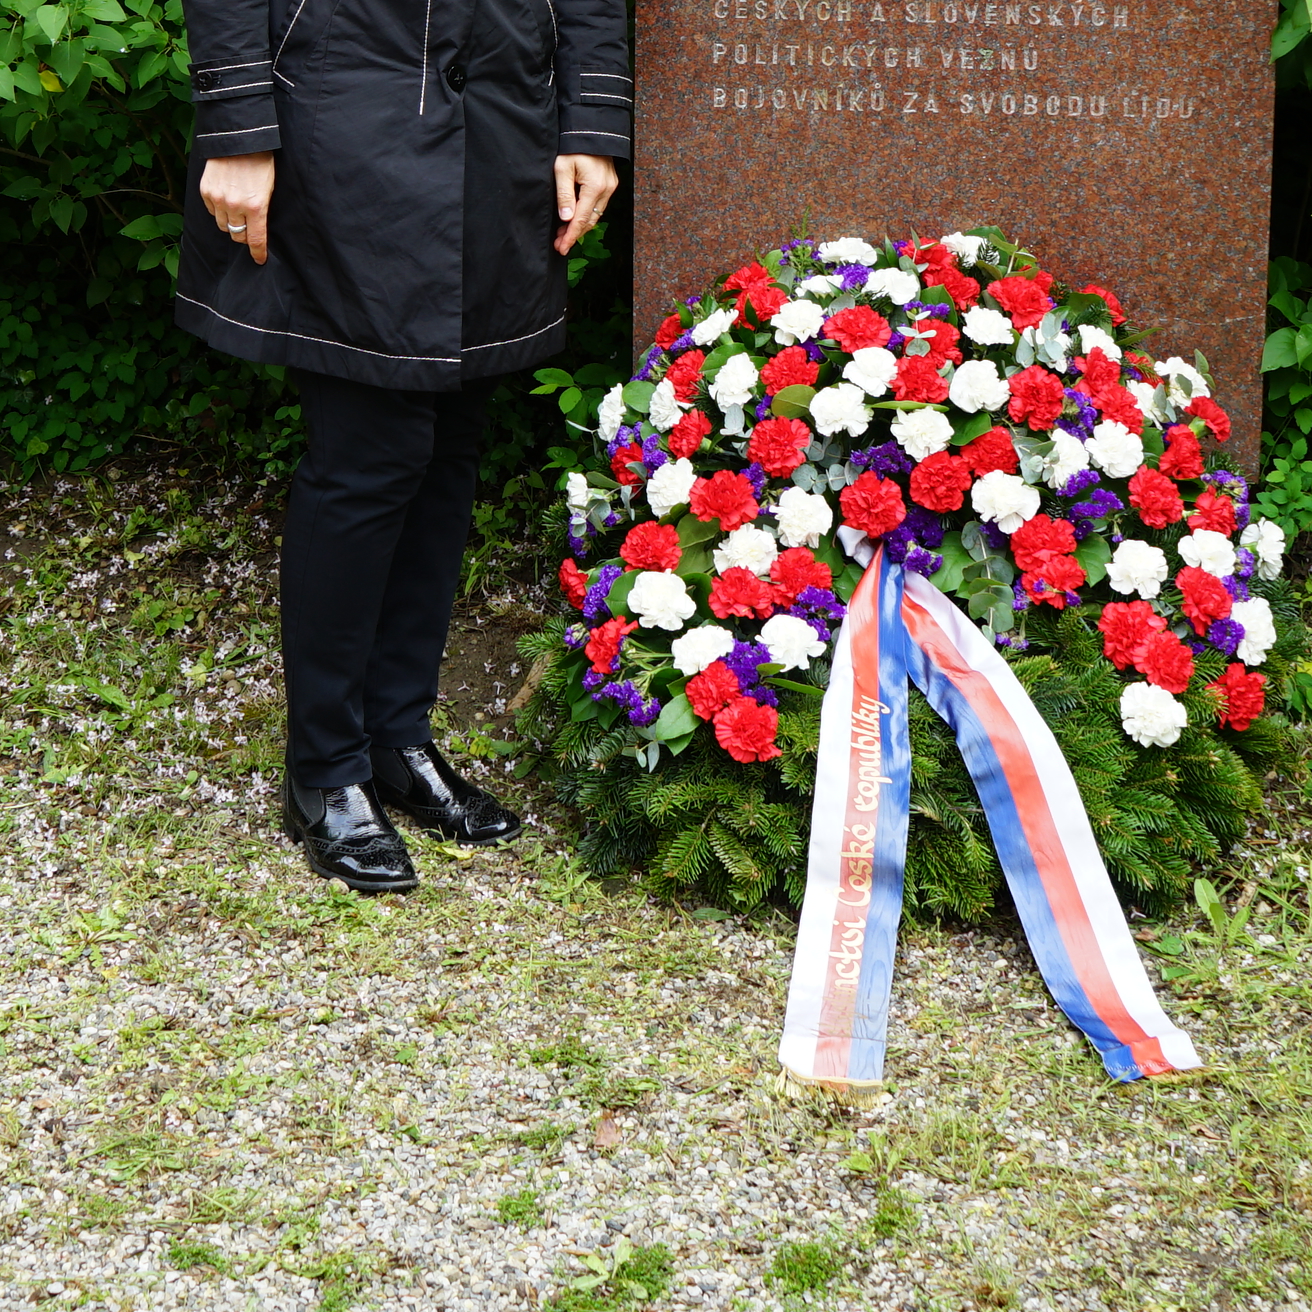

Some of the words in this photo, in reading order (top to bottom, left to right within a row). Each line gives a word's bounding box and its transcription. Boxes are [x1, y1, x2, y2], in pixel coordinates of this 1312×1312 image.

[870, 3, 886, 23] A
[713, 40, 921, 69] POLITICKÝCH
[713, 83, 885, 112] BOJOVNÍKŮ
[902, 91, 939, 114] ZA
[959, 92, 1107, 117] SVOBODU
[1122, 94, 1195, 119] LIDU
[850, 694, 893, 812] republiky
